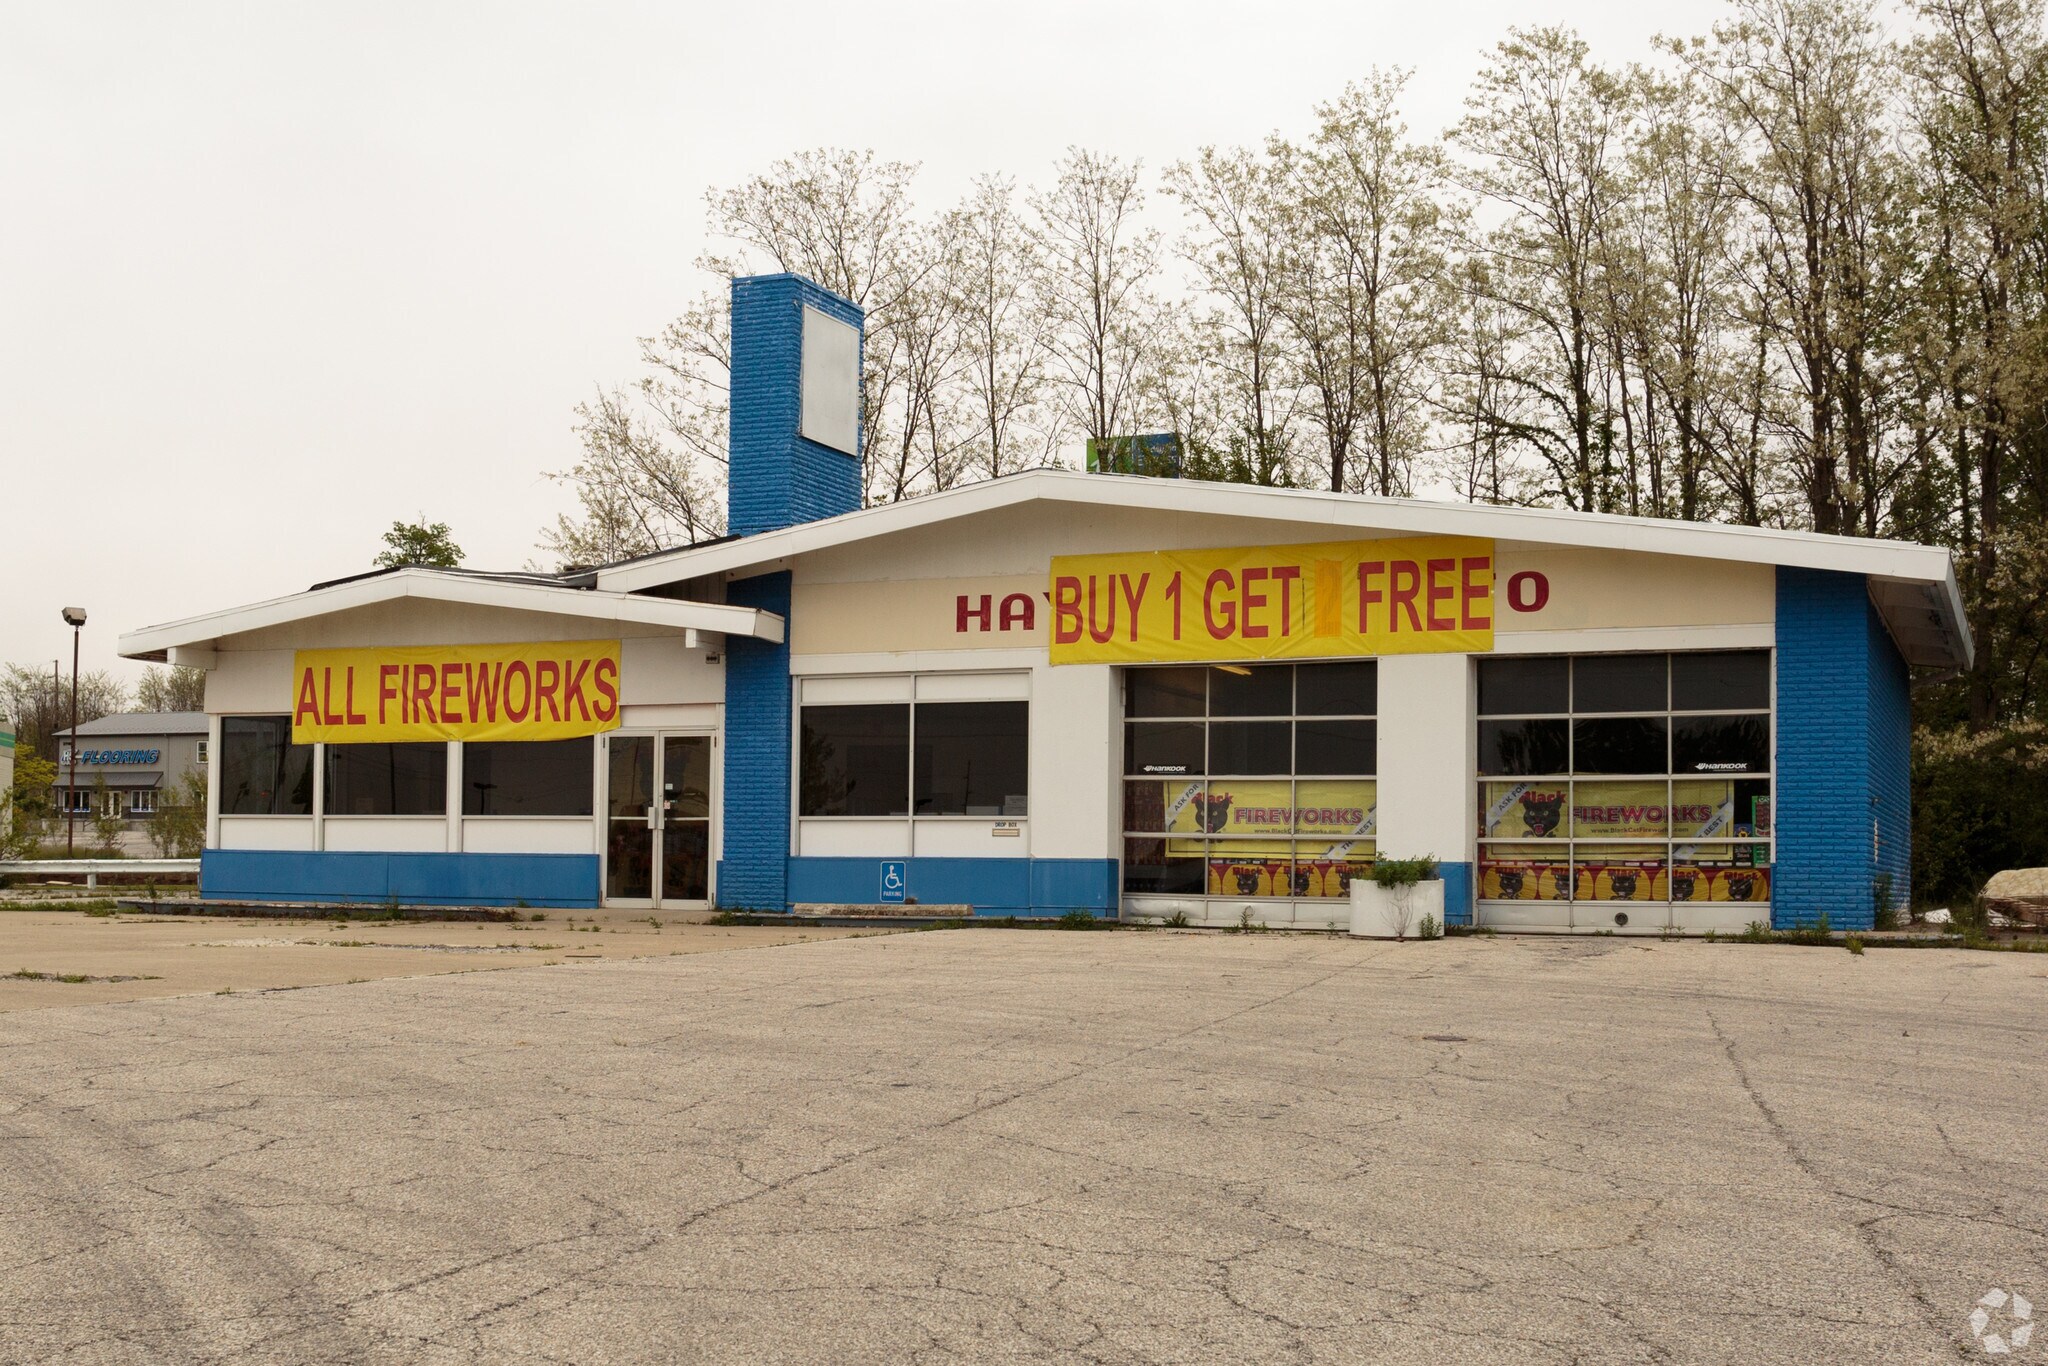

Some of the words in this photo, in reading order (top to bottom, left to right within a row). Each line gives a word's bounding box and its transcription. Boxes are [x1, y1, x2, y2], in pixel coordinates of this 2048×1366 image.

[956, 592, 1050, 632] HA
[1494, 571, 1550, 613] O
[1055, 572, 1150, 644] BUY
[1165, 570, 1182, 641] 1
[1203, 565, 1300, 641] GET
[1358, 556, 1491, 634] FREE
[295, 666, 367, 727] ALL
[379, 657, 618, 725] FIREWORKS
[81, 749, 160, 765] FLOORING
[1173, 797, 1187, 812] ASK
[1186, 783, 1200, 798] FOR
[1498, 796, 1513, 812] ASK
[1511, 782, 1527, 798] FOR
[1518, 790, 1567, 804] Black
[1233, 806, 1364, 825] FIREWORKS
[1567, 804, 1713, 825] FIREWORKS
[1703, 815, 1724, 836] BEST
[1283, 865, 1315, 875] Back
